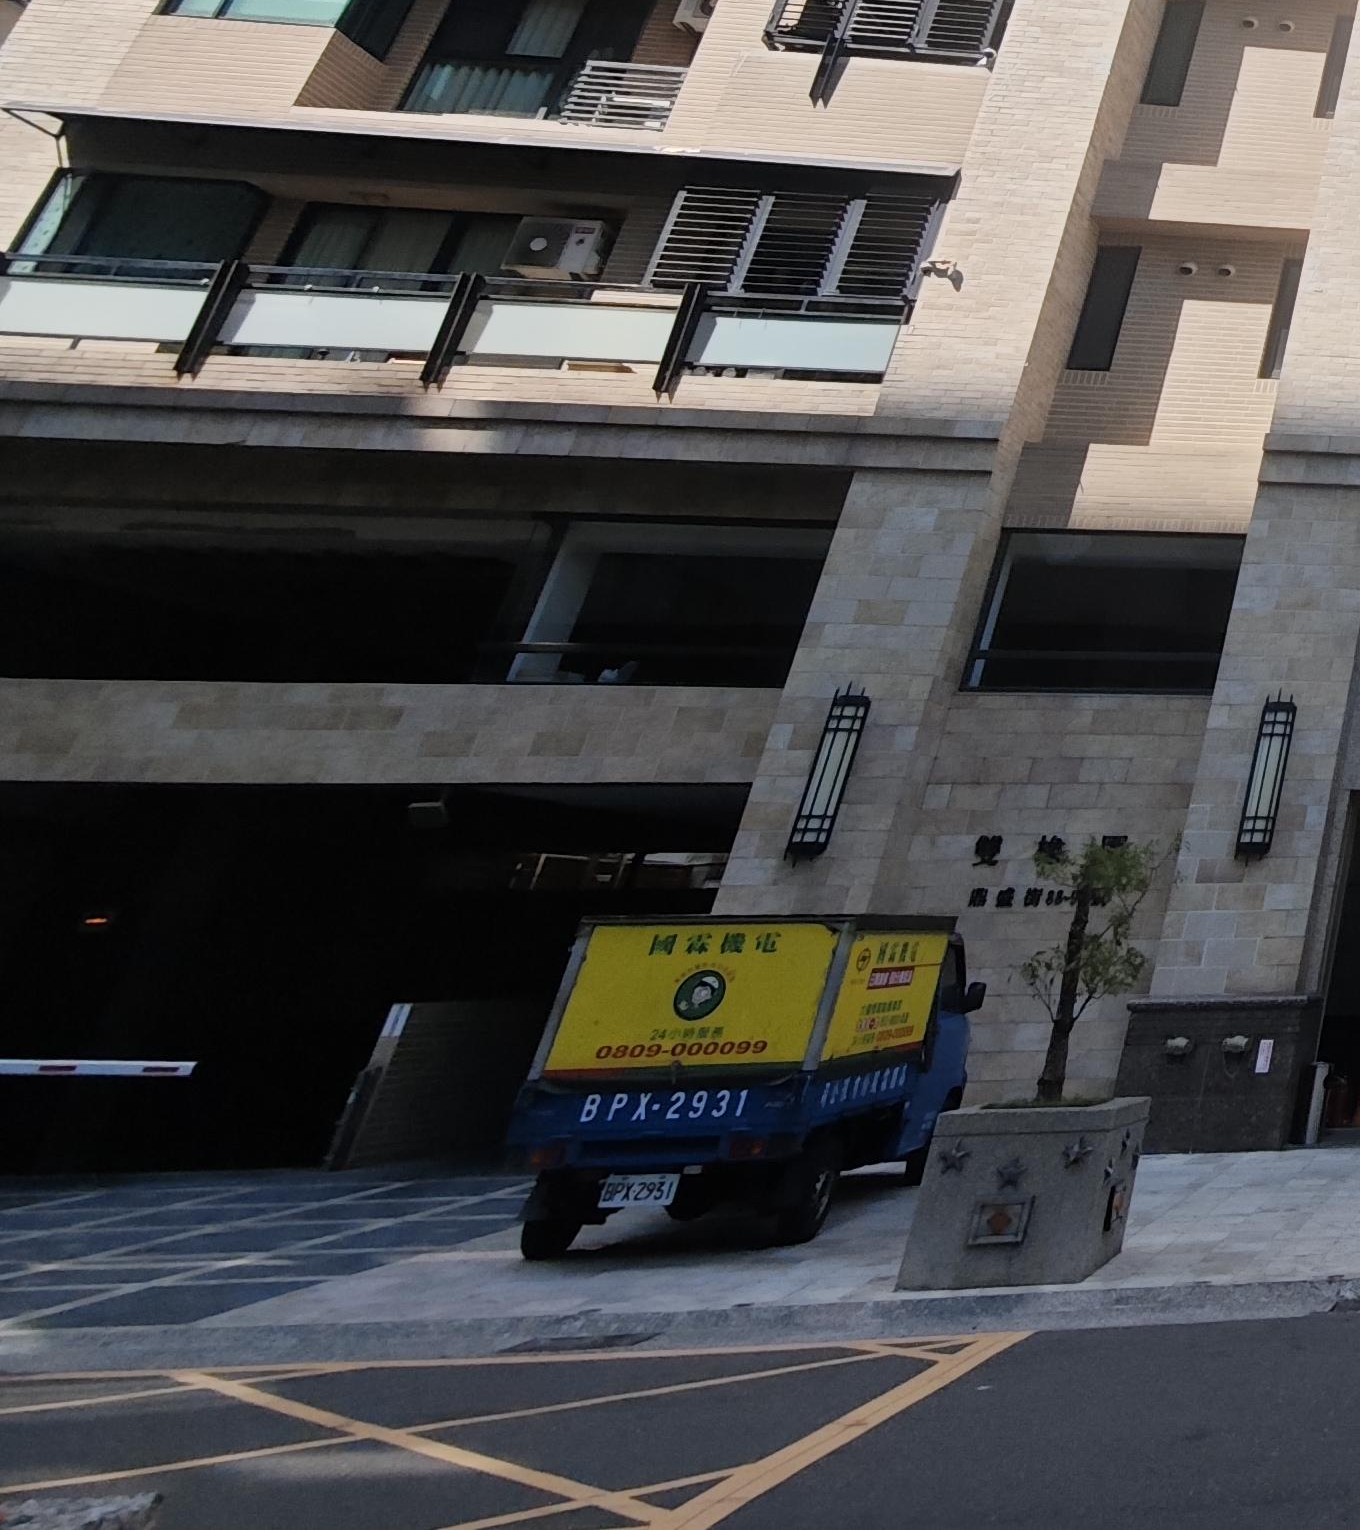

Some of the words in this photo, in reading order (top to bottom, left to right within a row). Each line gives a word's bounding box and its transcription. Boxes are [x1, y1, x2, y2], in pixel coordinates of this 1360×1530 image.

[595, 1040, 768, 1060] 0809-000099
[579, 1089, 749, 1123] BPX-2931
[602, 1181, 674, 1202] BPX-2931
